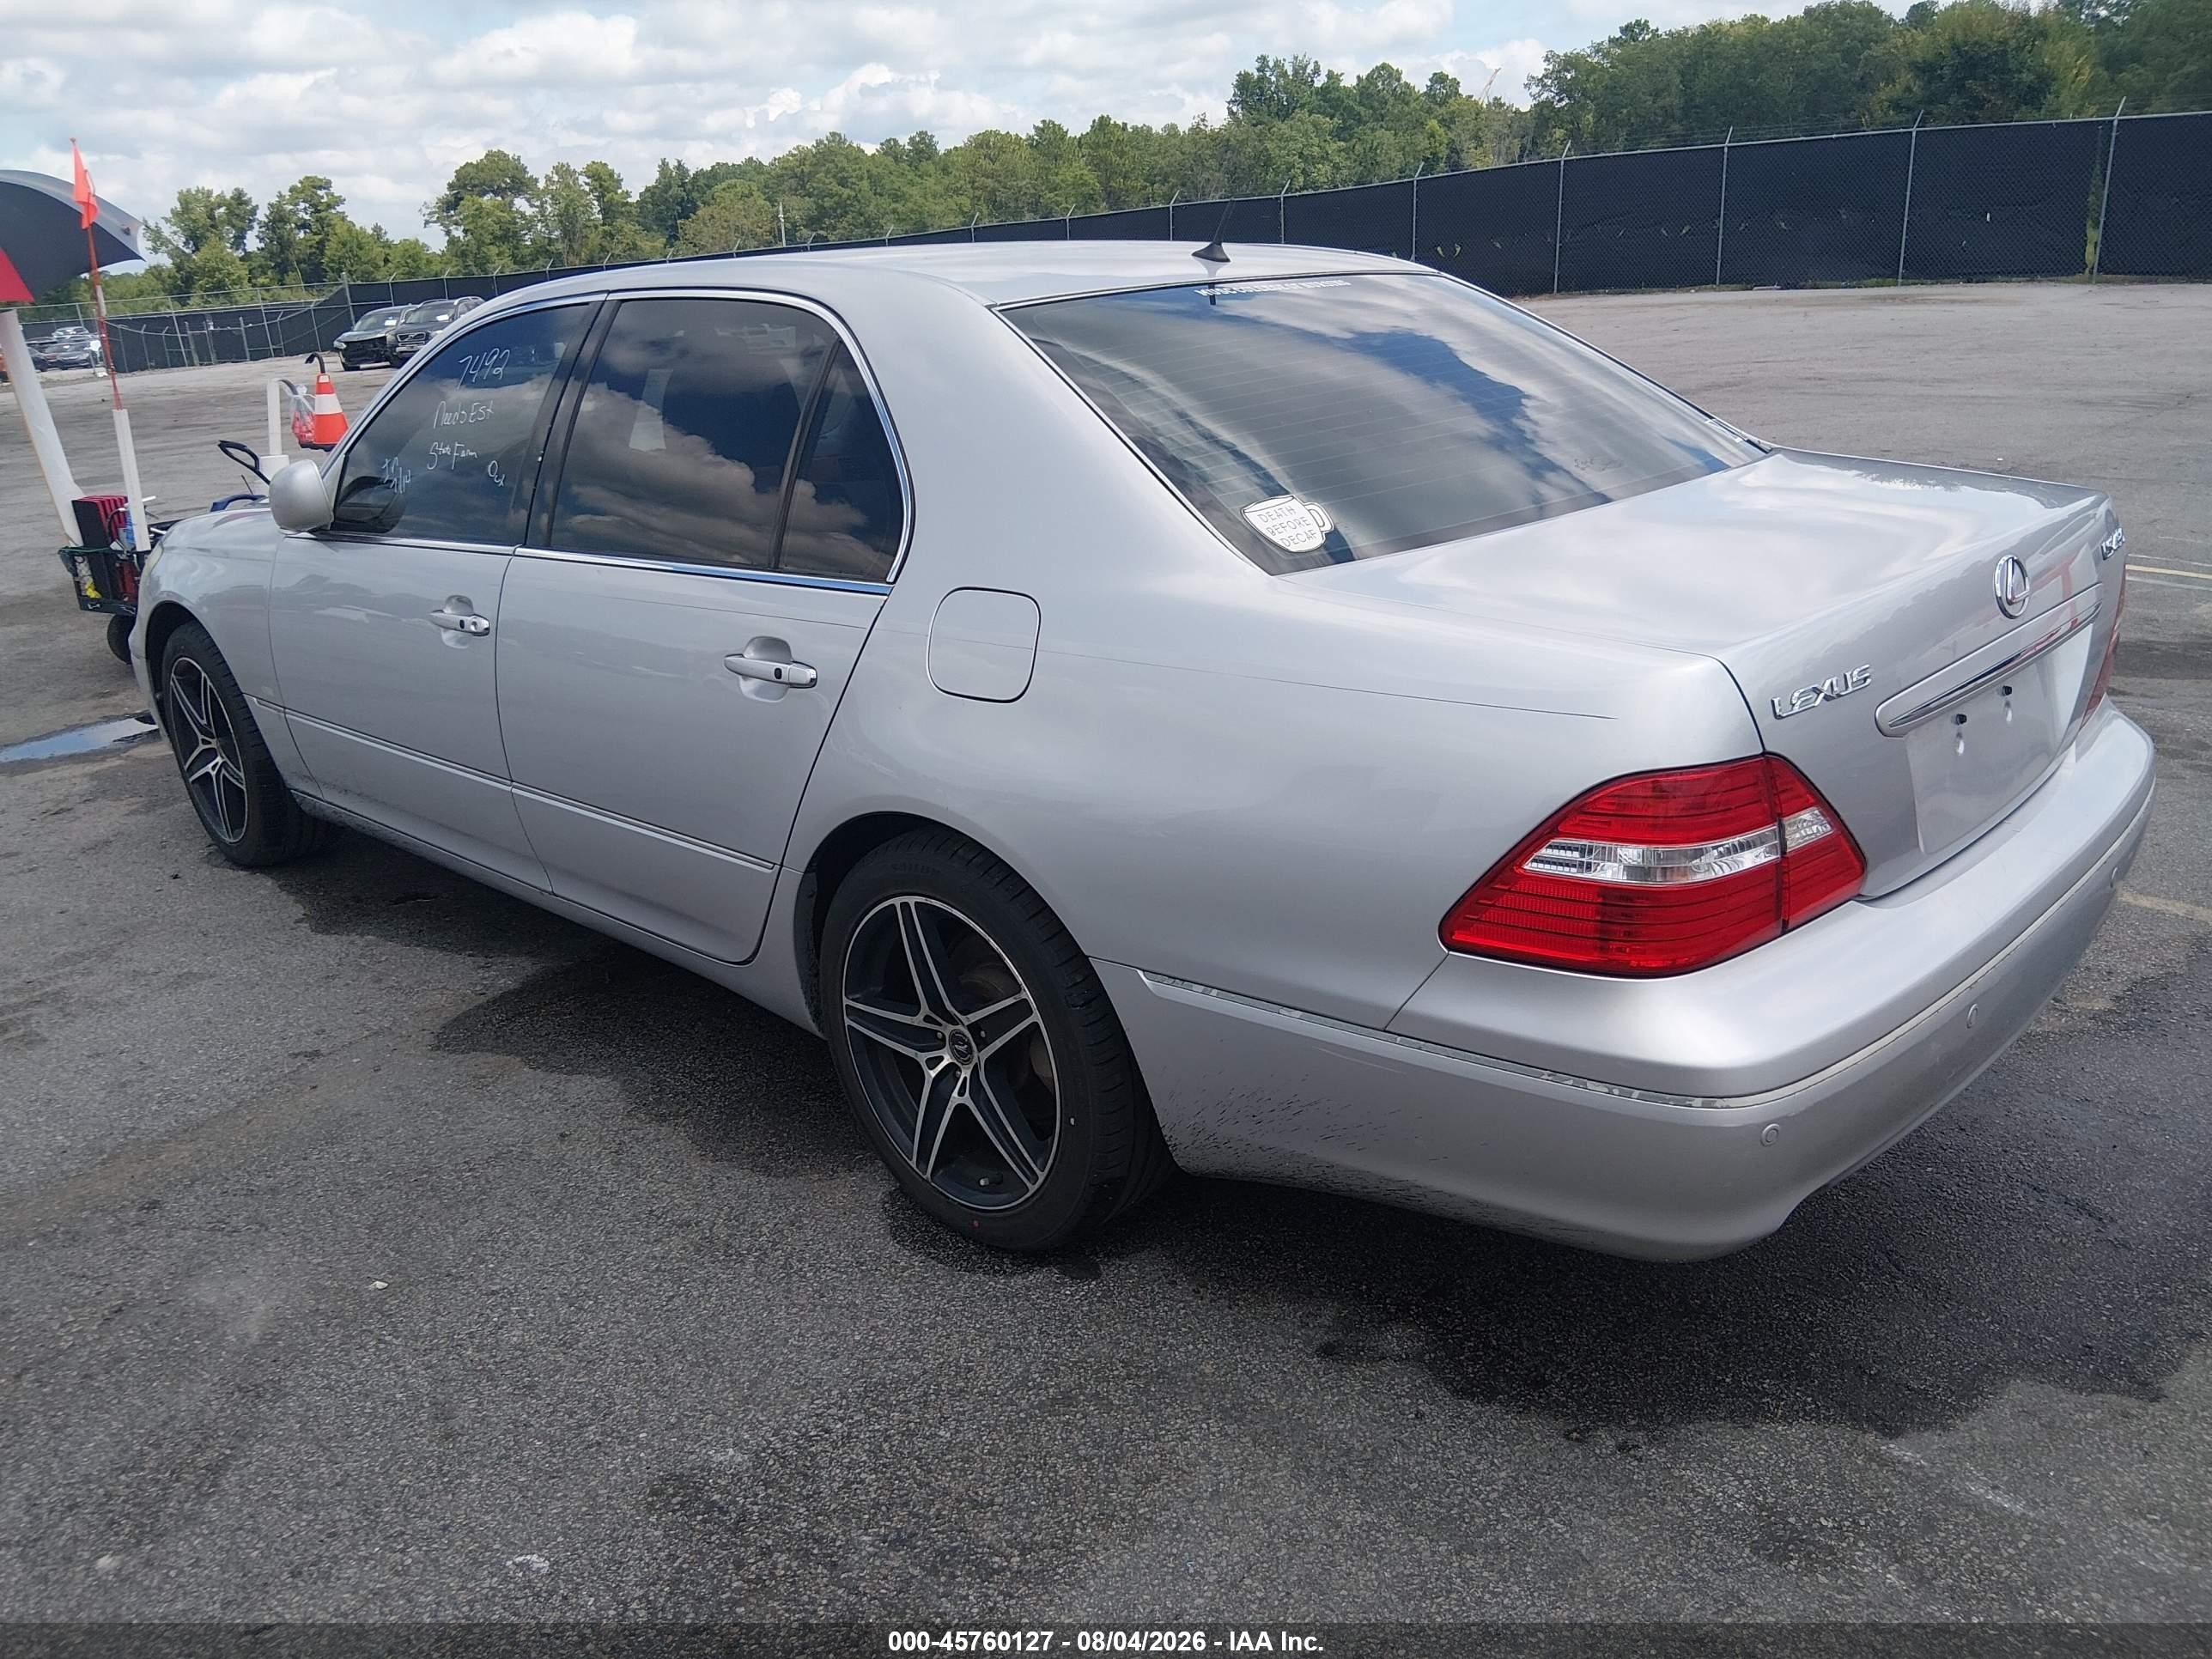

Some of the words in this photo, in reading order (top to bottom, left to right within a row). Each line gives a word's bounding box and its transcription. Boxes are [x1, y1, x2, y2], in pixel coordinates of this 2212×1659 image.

[458, 348, 511, 391] 7492
[1257, 505, 1297, 523] DEATH
[1266, 516, 1312, 537] BEFORE
[1279, 529, 1317, 548] DECAF
[1771, 664, 1872, 720] LEXUS
